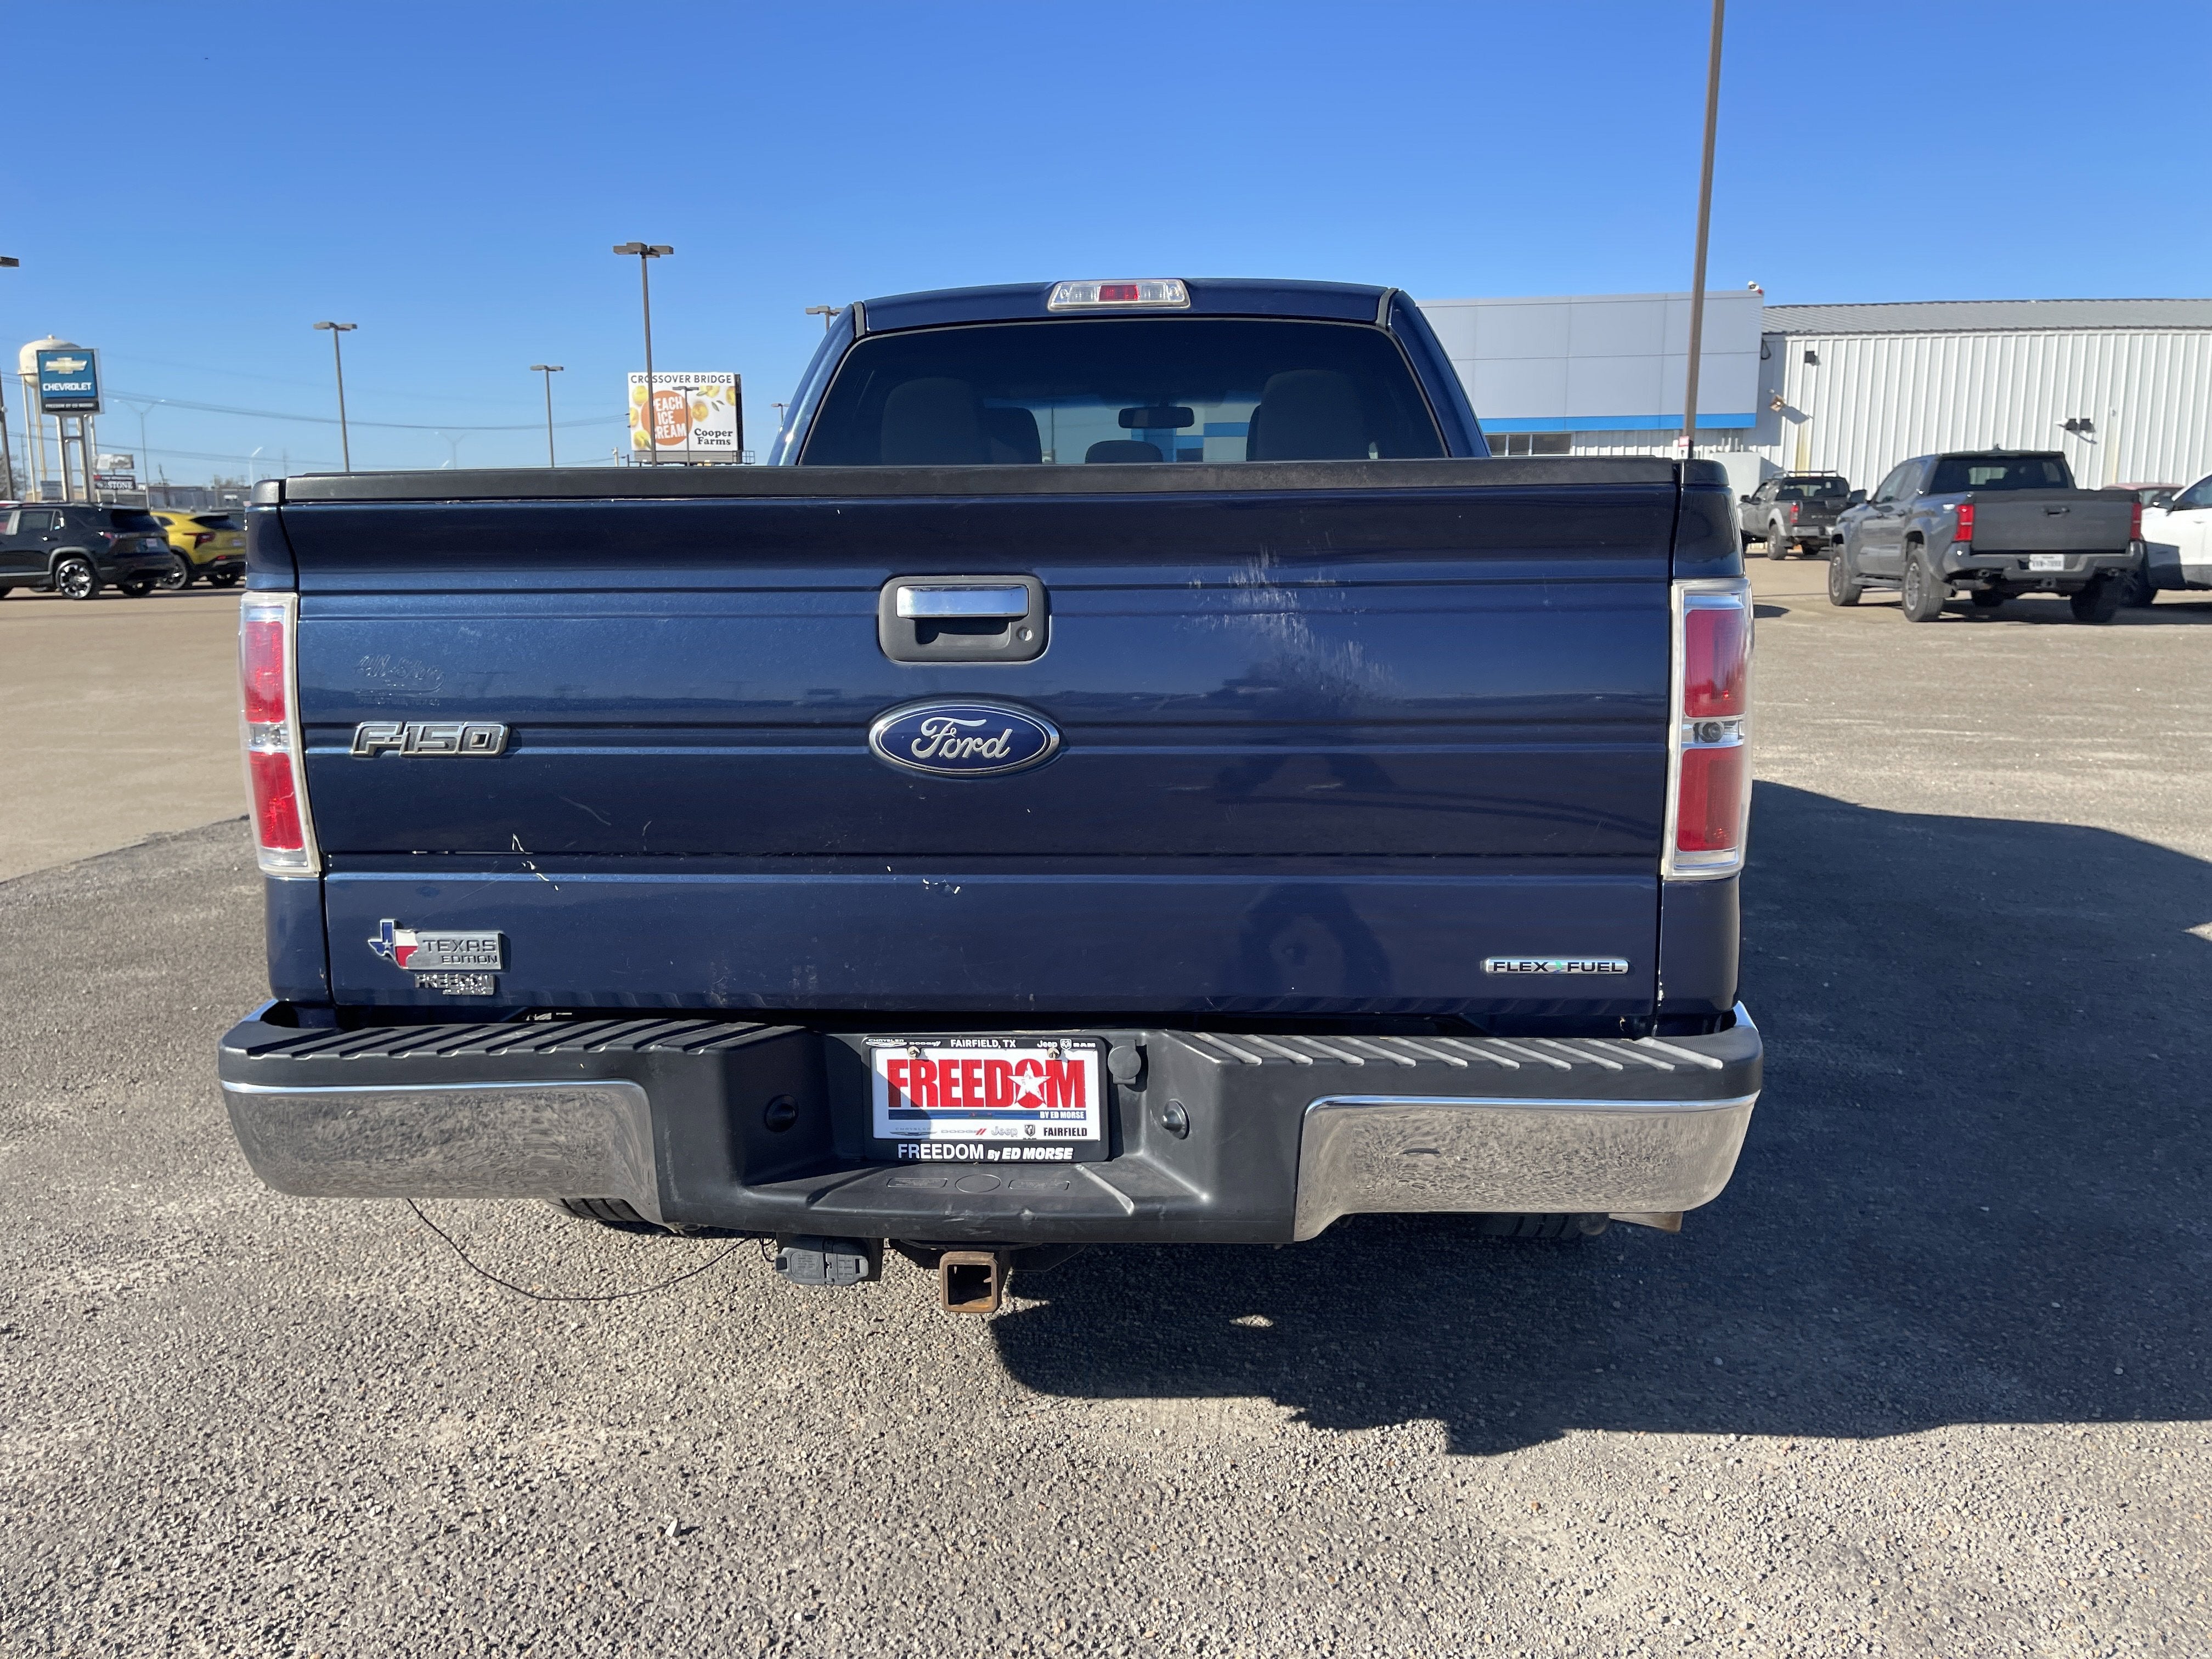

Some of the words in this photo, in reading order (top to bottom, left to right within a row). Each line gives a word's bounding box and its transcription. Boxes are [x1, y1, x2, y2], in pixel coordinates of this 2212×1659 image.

[694, 375, 732, 383] BRIDGE
[43, 382, 92, 391] CHEVROLET
[657, 410, 675, 426] ICE
[694, 428, 733, 437] Cooper
[697, 437, 731, 445] Farms
[911, 716, 1013, 759] Ford
[422, 939, 497, 953] TEXAS
[442, 955, 498, 964] EDITION
[1493, 961, 1549, 972] FLEX
[1567, 961, 1623, 972] FUEL
[950, 1039, 1001, 1049] FAIRFIELD,
[1002, 1039, 1017, 1048] TX
[887, 1058, 1086, 1109] FREEDOM
[1040, 1111, 1049, 1119] BY
[1050, 1111, 1059, 1119] ED
[1060, 1111, 1085, 1120] MORSE
[991, 1126, 1018, 1137] Jeep
[1043, 1127, 1087, 1137] FAIRFIELD
[898, 1143, 984, 1160] FREEDOM
[1002, 1147, 1022, 1160] ED
[1022, 1147, 1074, 1160] MORSE
